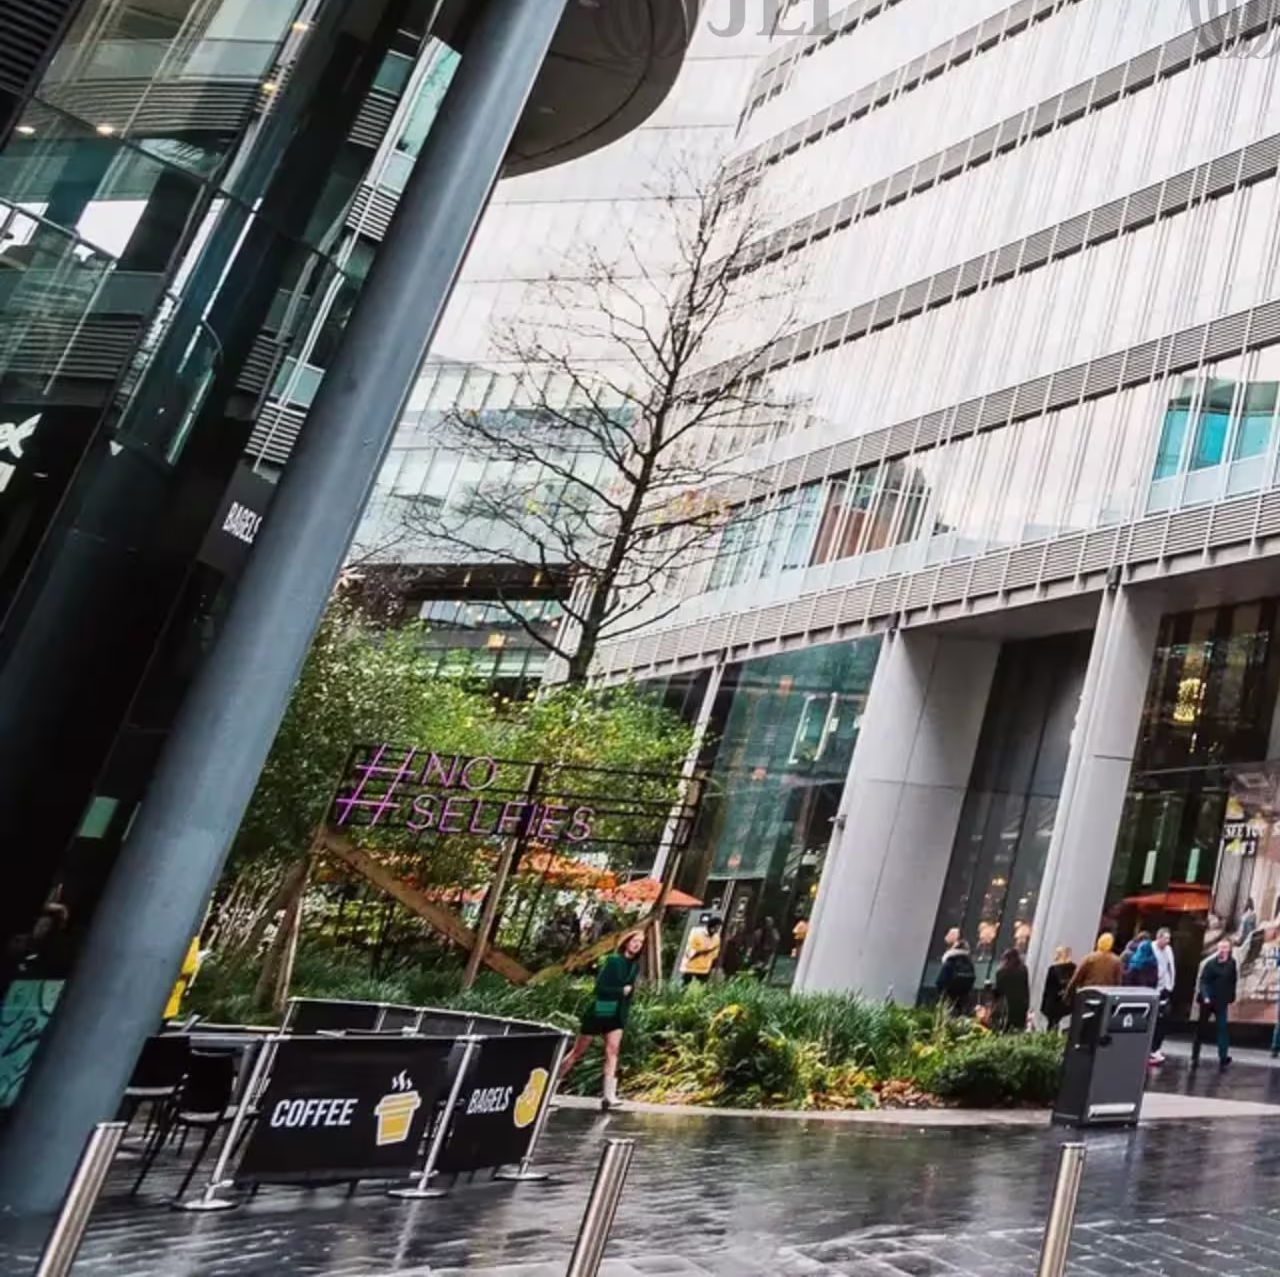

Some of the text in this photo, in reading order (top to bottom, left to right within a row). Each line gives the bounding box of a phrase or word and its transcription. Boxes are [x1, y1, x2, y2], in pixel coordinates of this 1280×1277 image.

[406, 793, 596, 842] SELFIES
[270, 1098, 359, 1128] COFFEE
[466, 1086, 514, 1114] BAGELS
